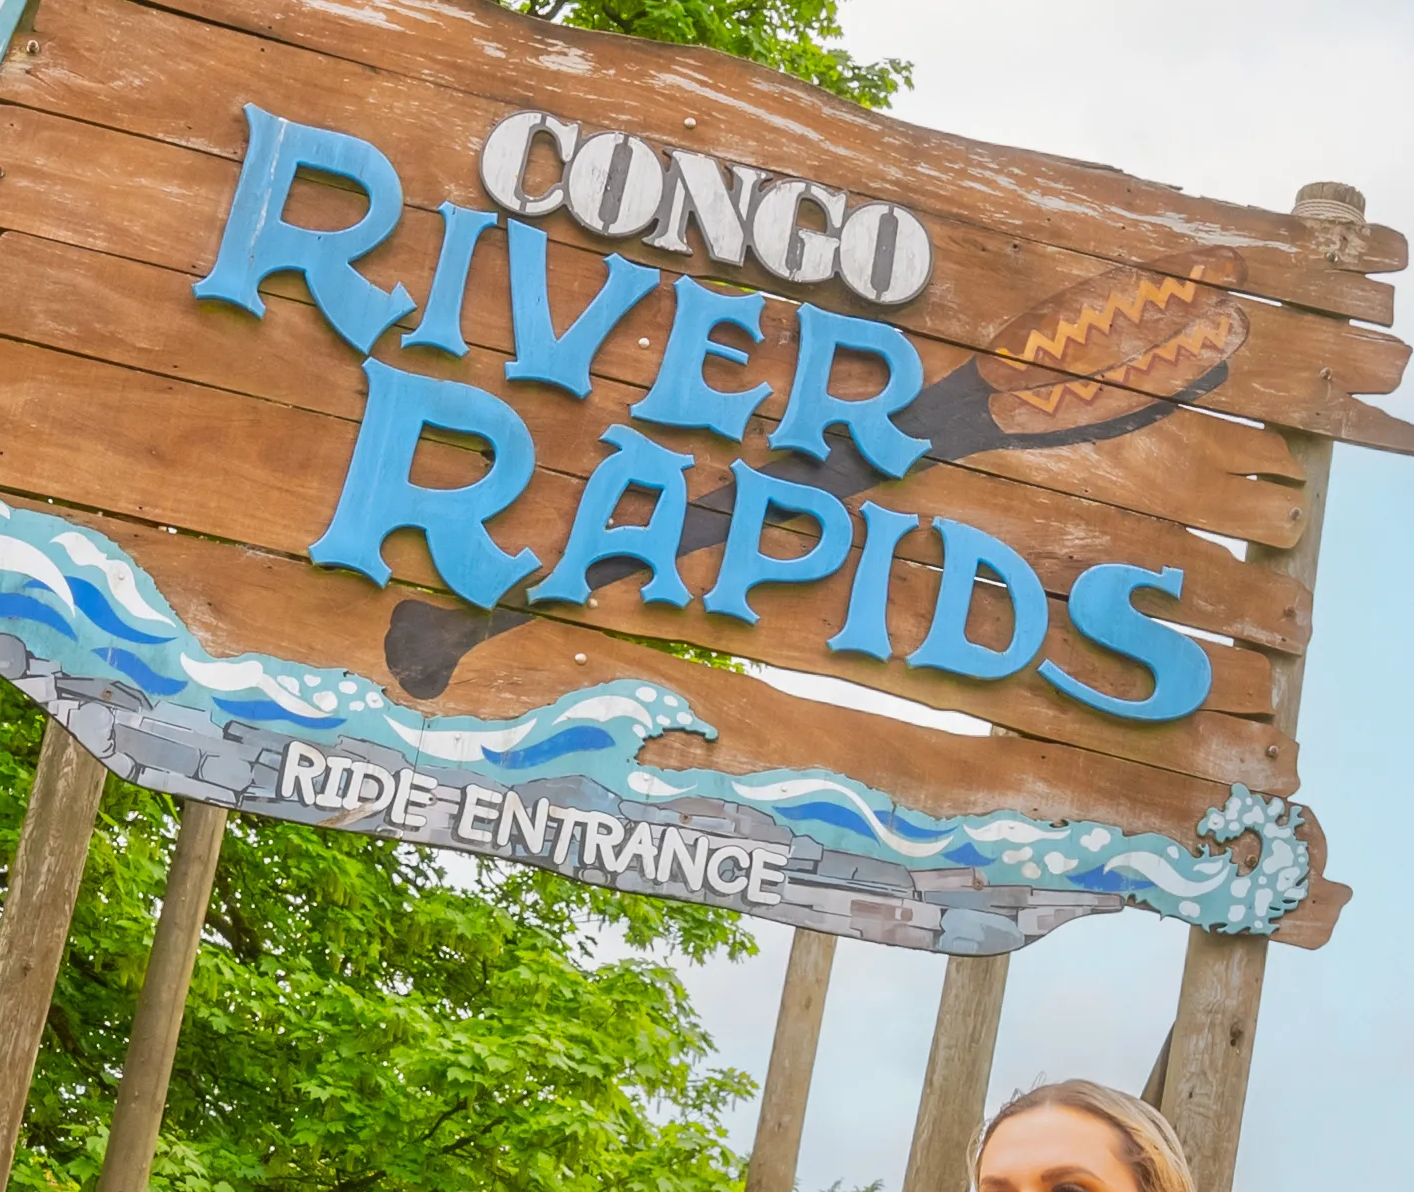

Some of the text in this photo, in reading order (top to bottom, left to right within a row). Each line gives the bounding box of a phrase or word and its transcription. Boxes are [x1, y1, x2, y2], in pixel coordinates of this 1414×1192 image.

[193, 102, 934, 480] RIVER
[478, 111, 935, 306] CONGO
[307, 355, 1213, 723] RAPIDS
[281, 740, 790, 904] RIDE ENTRANCE
